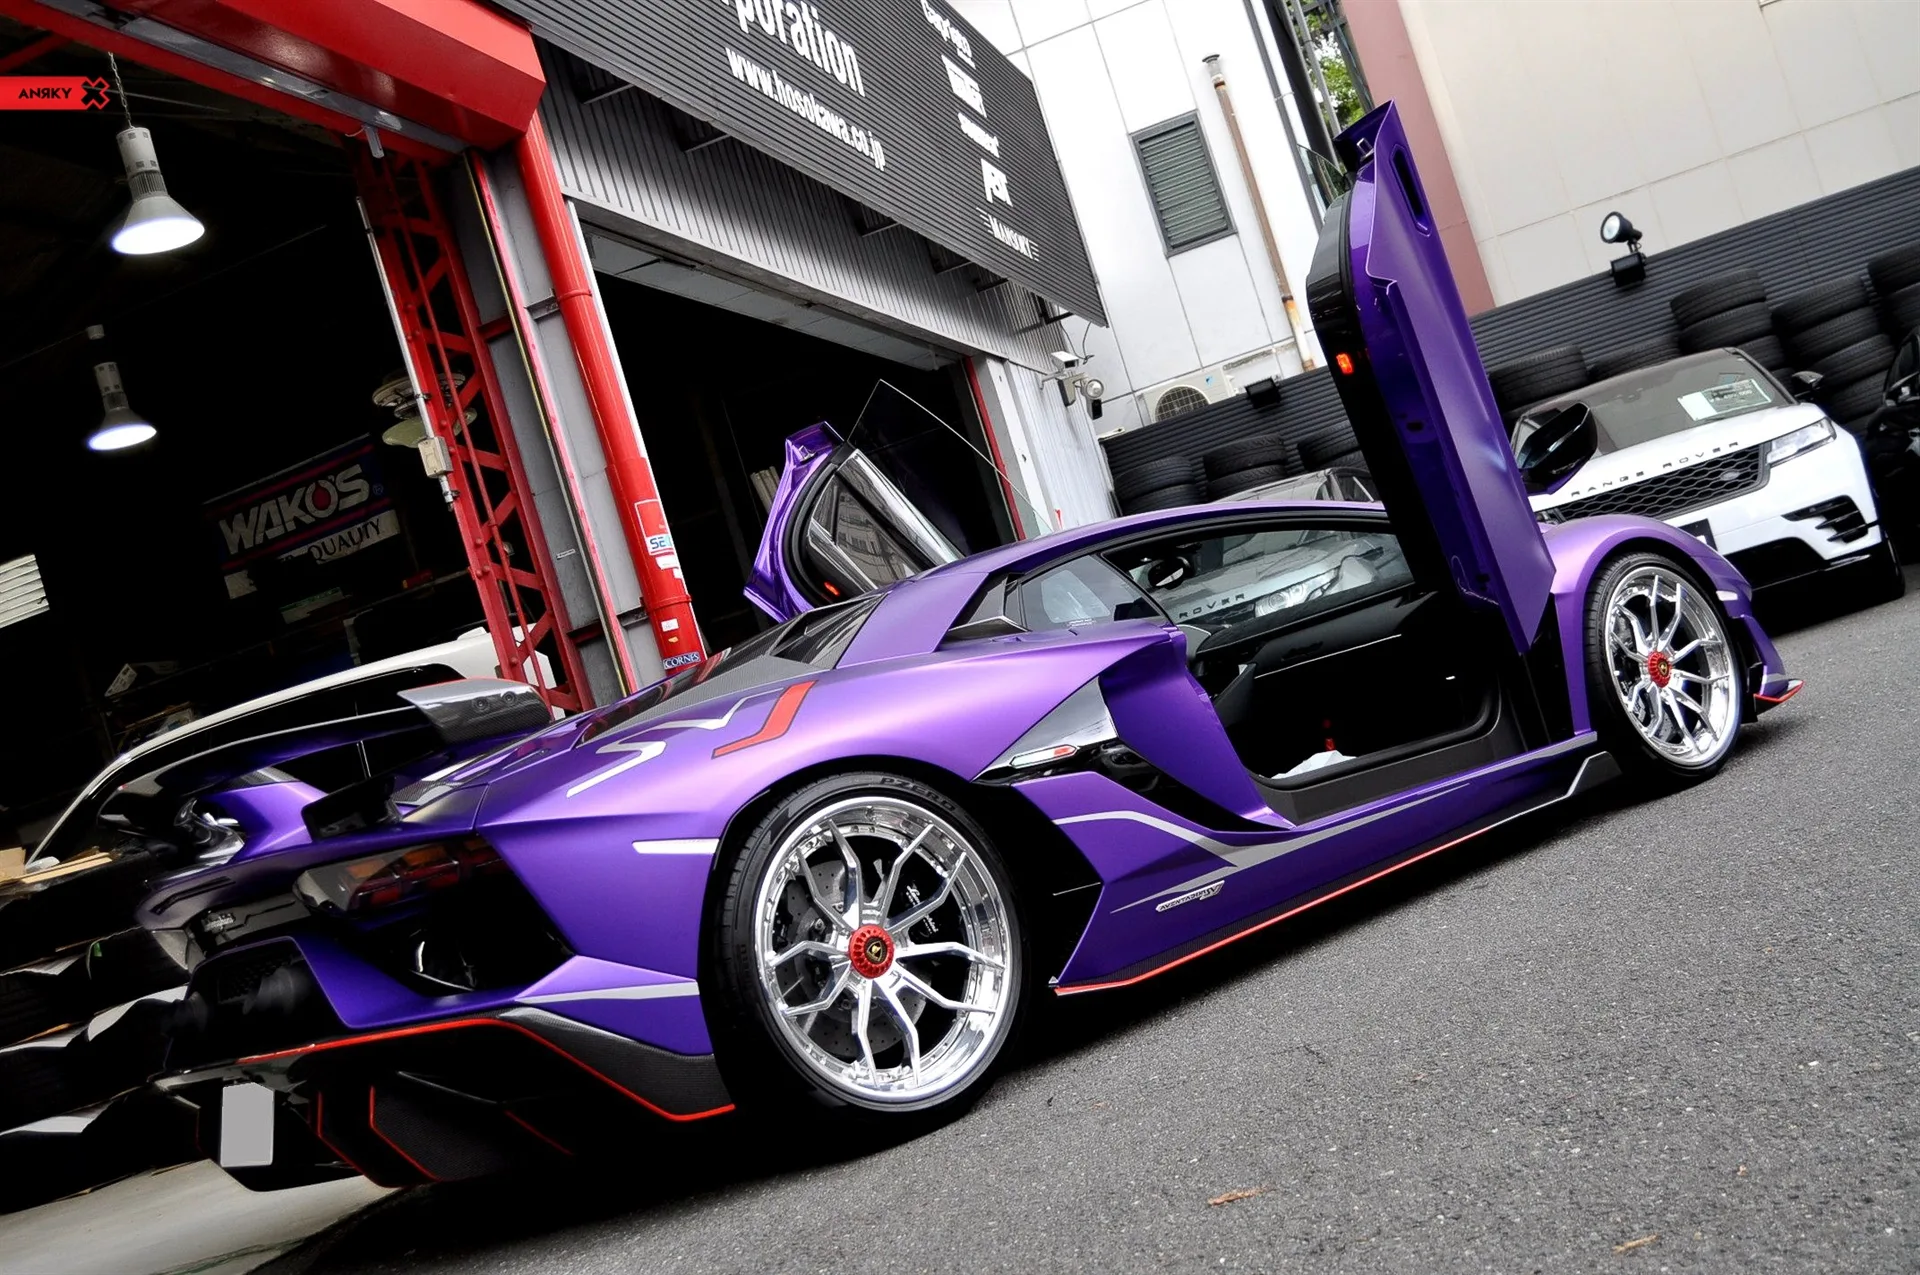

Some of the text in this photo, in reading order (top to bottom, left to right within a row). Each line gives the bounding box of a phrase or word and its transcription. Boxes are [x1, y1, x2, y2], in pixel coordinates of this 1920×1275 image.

[725, 47, 886, 171] www.hosokawa.co.jp
[1571, 442, 1738, 497] RANGE ROVER
[218, 463, 370, 555] WAKO'S
[307, 517, 381, 562] QUALITY
[1178, 593, 1246, 619] ROVER
[665, 653, 699, 668] CORNES
